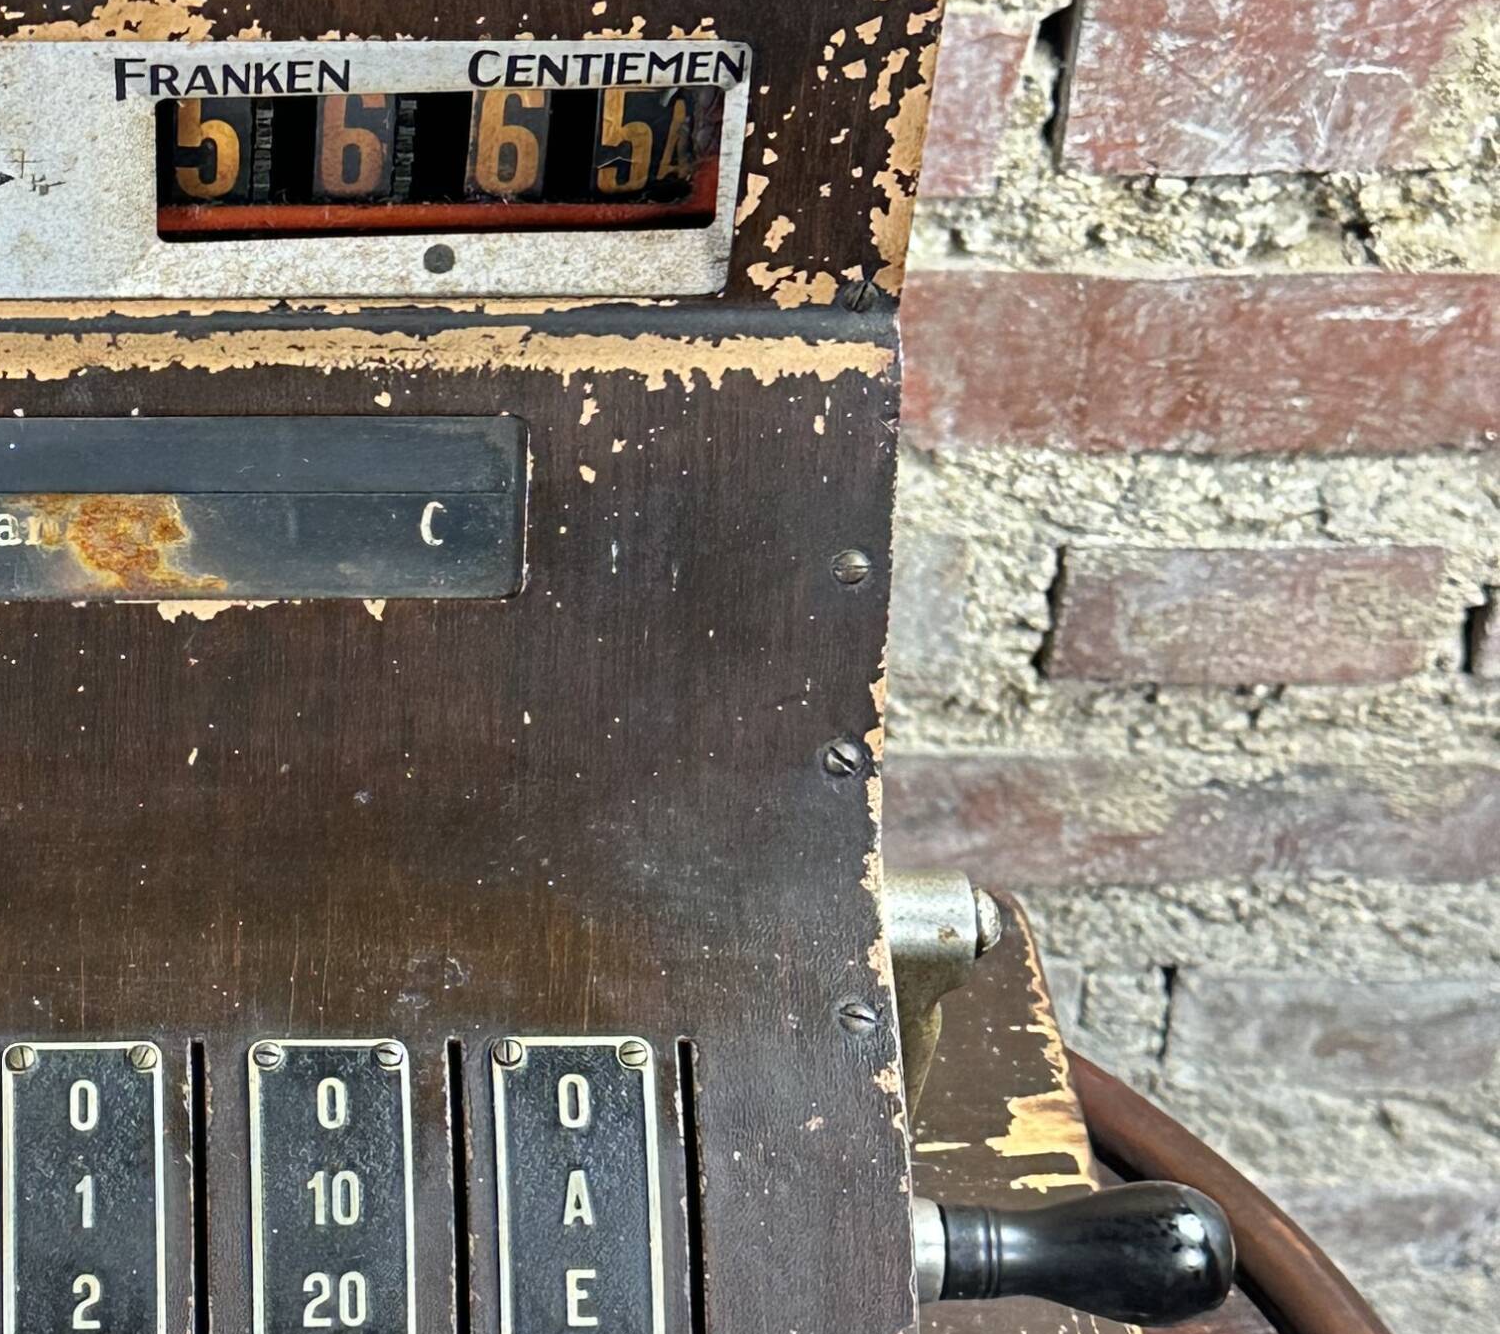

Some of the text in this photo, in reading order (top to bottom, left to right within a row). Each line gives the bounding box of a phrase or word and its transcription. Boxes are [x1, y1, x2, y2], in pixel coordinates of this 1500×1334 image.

[114, 49, 747, 101] FRANKEN CENTIEMEN
[174, 97, 241, 199] 5
[319, 94, 388, 197] 6
[472, 89, 544, 196] 6
[69, 1079, 98, 1132] 0
[316, 1077, 347, 1130] 0
[74, 1174, 94, 1229] 1
[306, 1170, 360, 1226] 10
[563, 1170, 594, 1226] A
[72, 1273, 101, 1330] 2
[302, 1271, 367, 1328] 20
[566, 1269, 598, 1327] E
